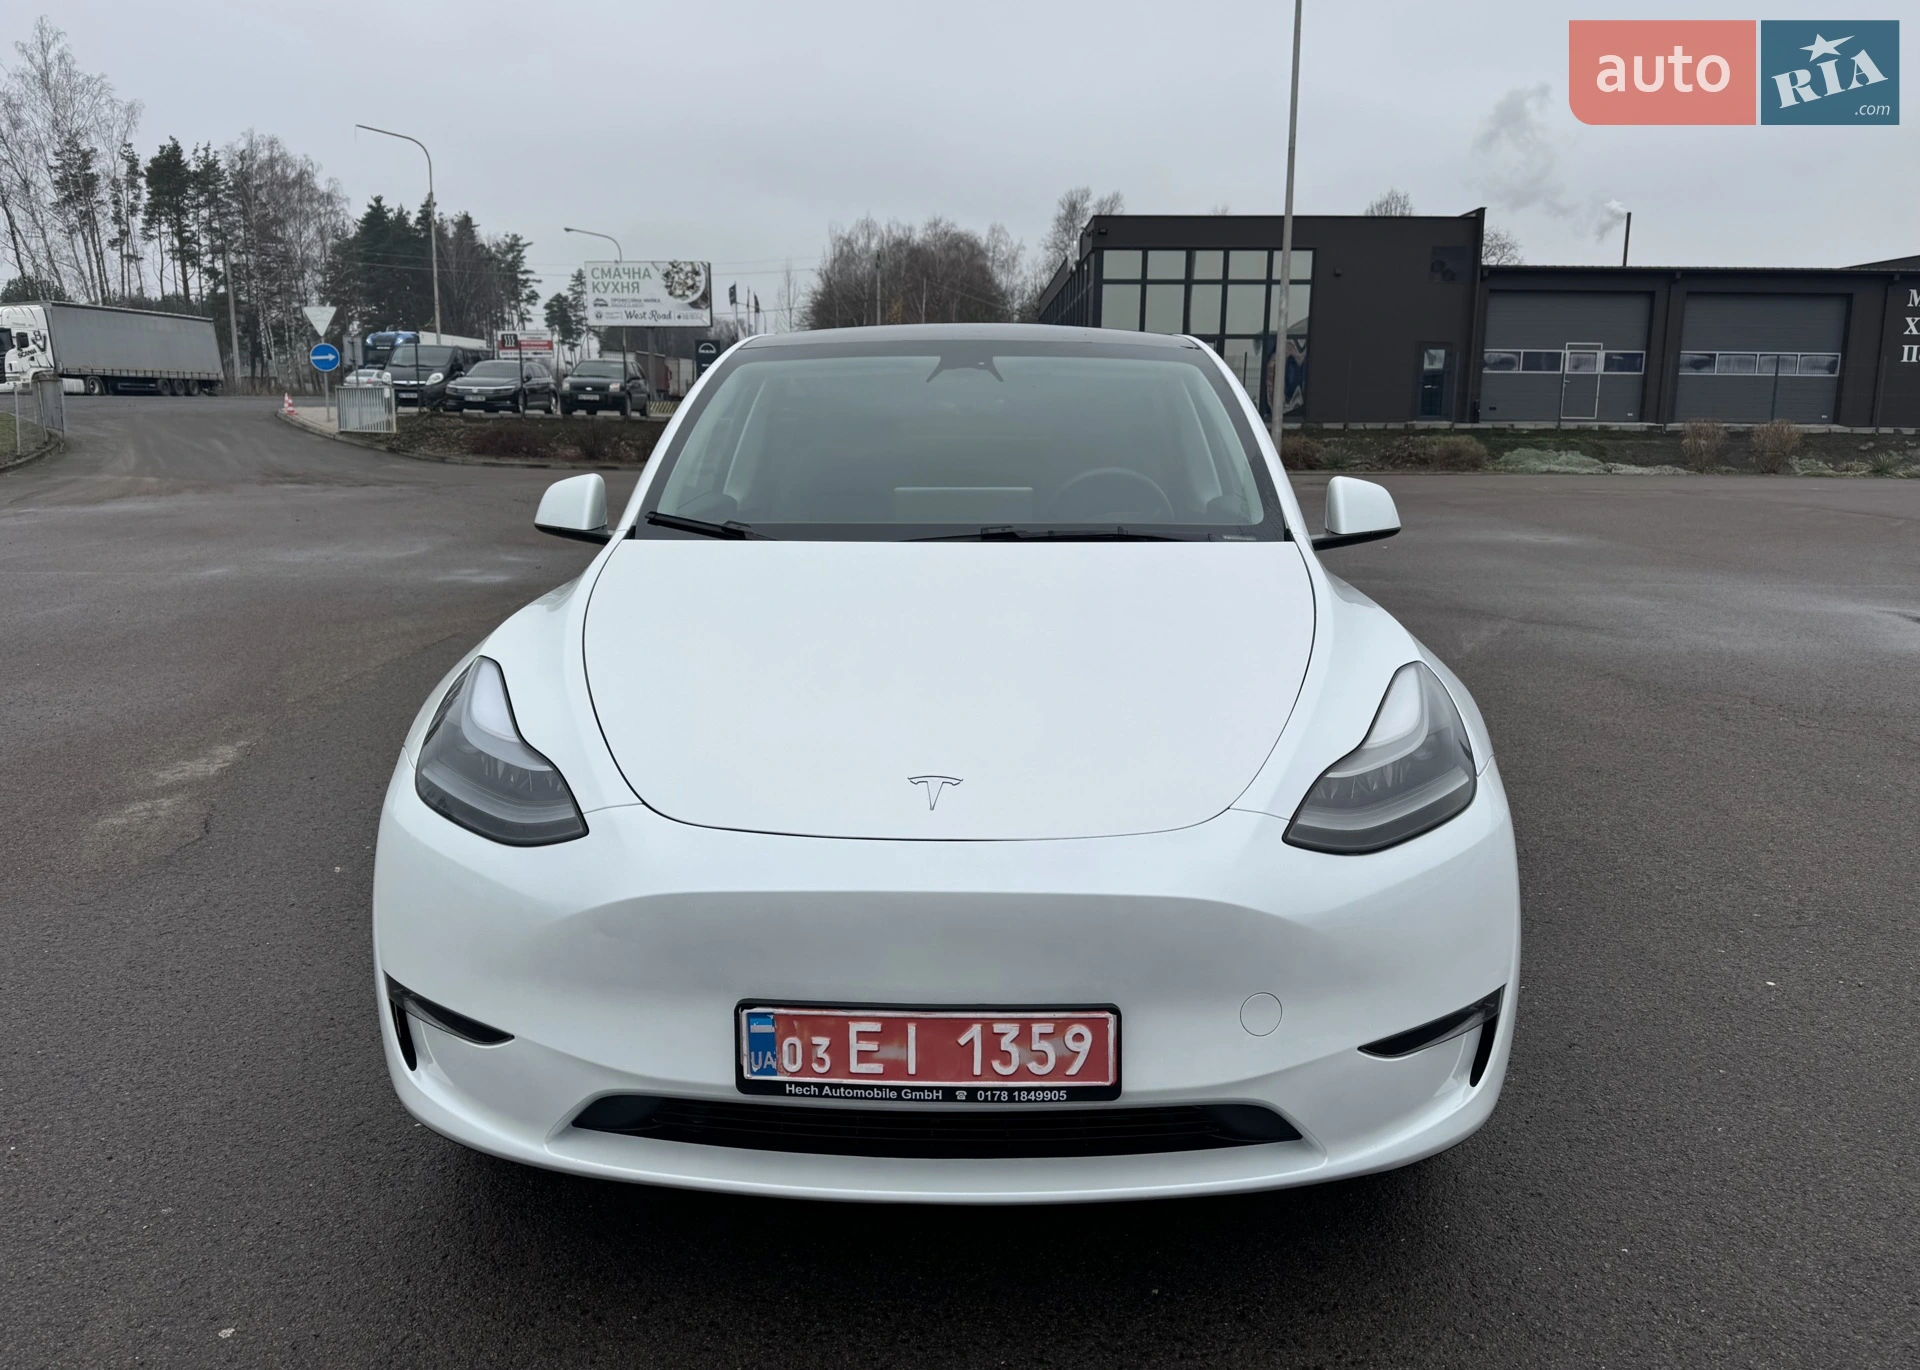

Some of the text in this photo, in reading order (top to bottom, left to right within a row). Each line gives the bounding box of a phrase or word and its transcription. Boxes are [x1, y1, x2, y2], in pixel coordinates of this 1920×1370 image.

[591, 267, 652, 280] СМАЧНА
[592, 281, 640, 294] КУХНЯ
[624, 309, 646, 320] West
[648, 309, 672, 322] Road
[1900, 344, 1920, 363] П
[781, 1021, 1093, 1077] 03 EI 1359
[750, 1050, 776, 1073] UA
[785, 1083, 1067, 1101] Hech Automobile GmbH 0178 1849905
